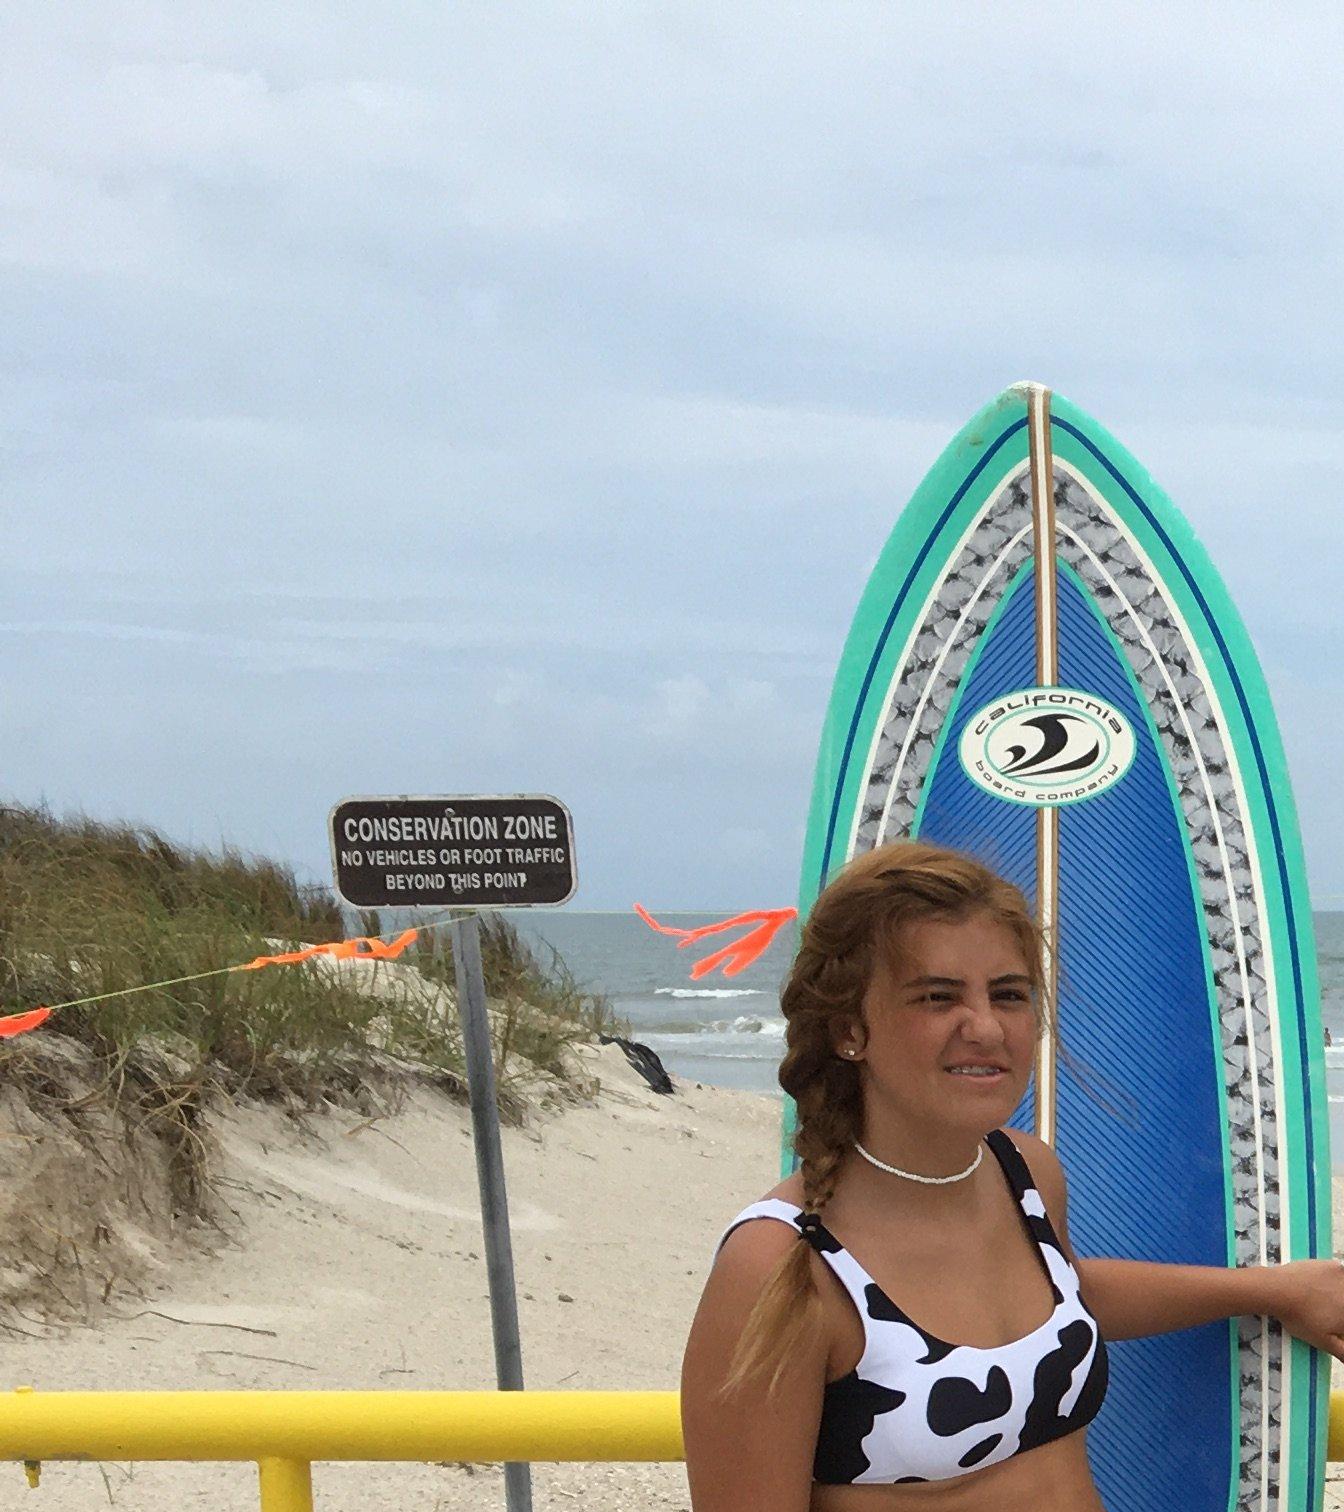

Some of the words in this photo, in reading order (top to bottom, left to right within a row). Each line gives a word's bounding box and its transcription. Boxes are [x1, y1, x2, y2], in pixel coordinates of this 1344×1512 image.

[975, 760, 1027, 798] board
[1035, 764, 1119, 800] company
[344, 815, 498, 842] CONSERVATION
[503, 815, 558, 840] ZONE
[341, 850, 363, 866] NO
[366, 849, 437, 866] VEHICLES
[439, 849, 461, 865] OR
[464, 848, 502, 864] FOOT
[502, 848, 565, 864] TRAFFIC
[386, 873, 445, 890] BEYOND
[448, 873, 481, 890] THIS
[484, 872, 527, 888] POINT
